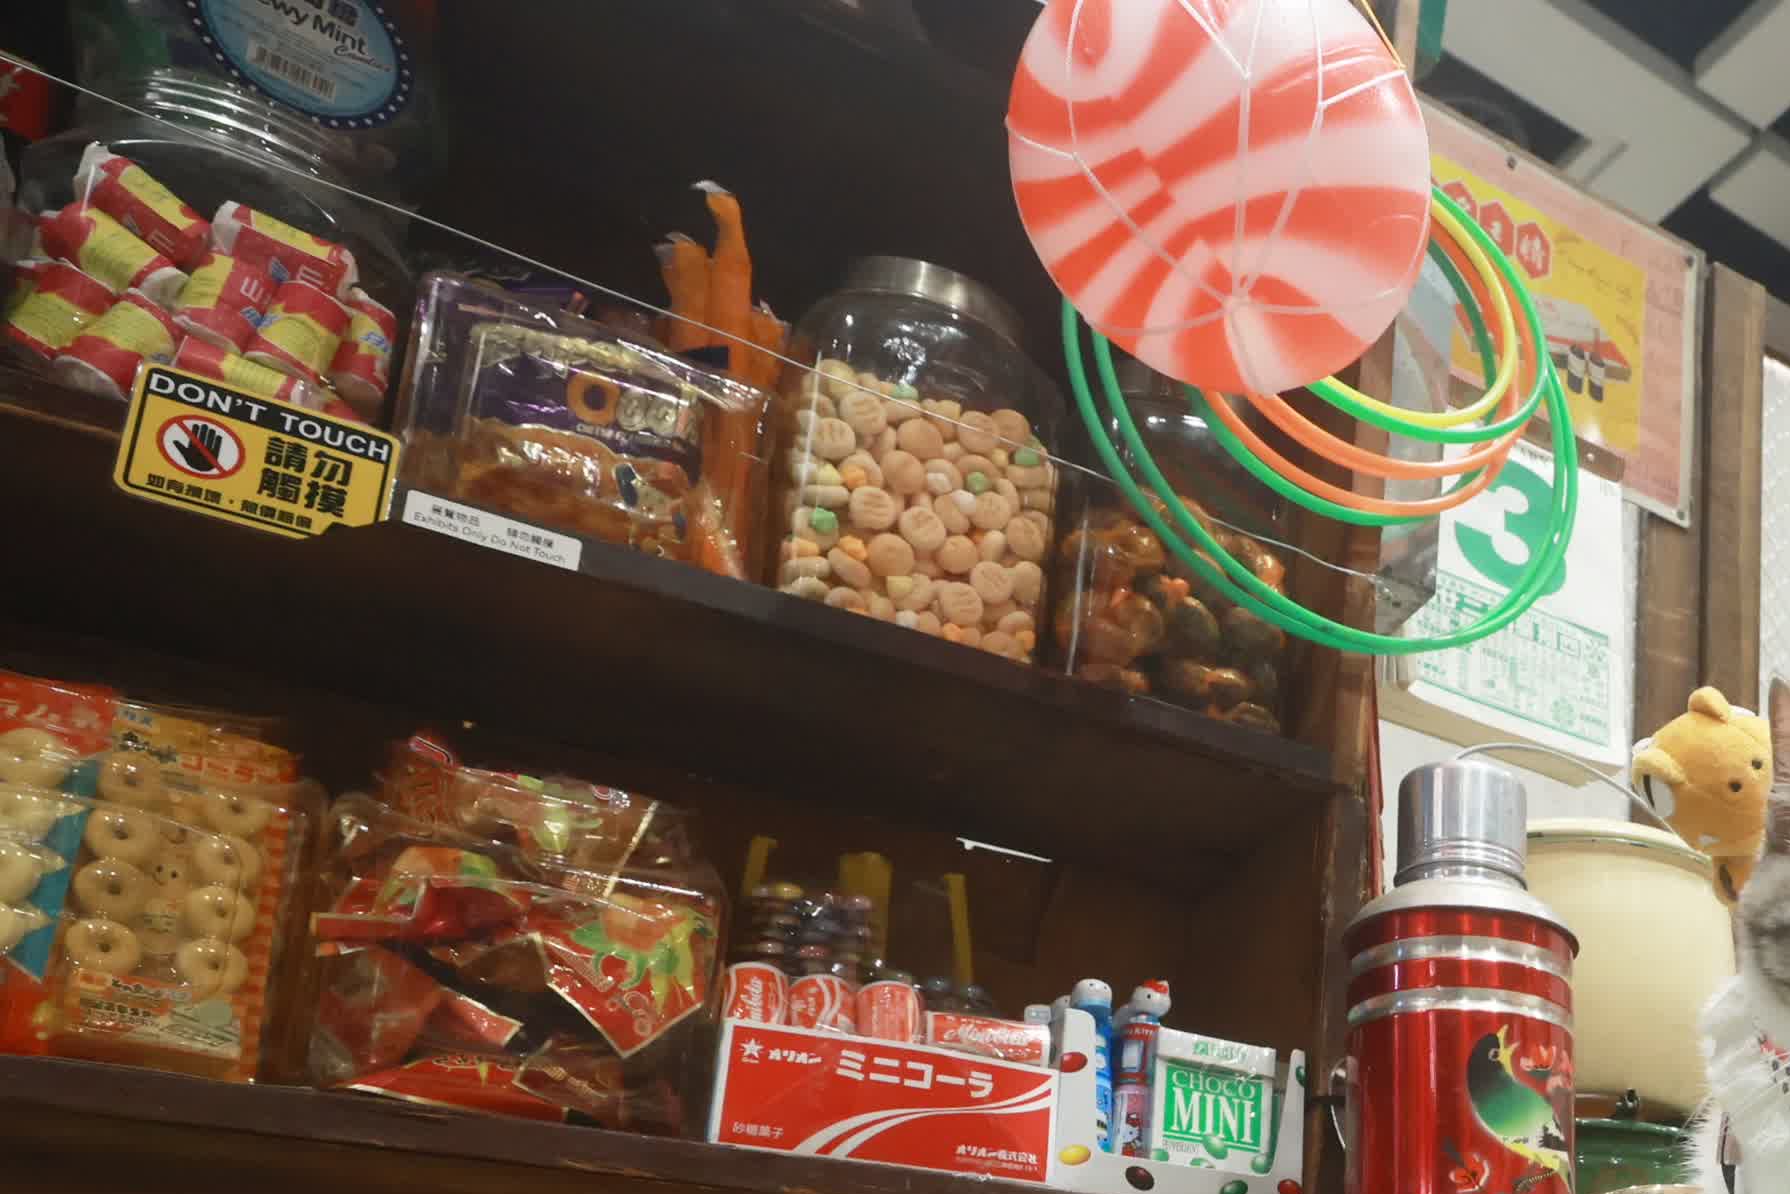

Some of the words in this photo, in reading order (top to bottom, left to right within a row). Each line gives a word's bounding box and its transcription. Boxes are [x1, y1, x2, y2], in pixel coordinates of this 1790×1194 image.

[312, 14, 367, 55] Mint
[150, 373, 268, 422] DON'T
[279, 412, 389, 463] TOUCH
[264, 435, 353, 487] 請勿
[257, 467, 348, 518] 觸摸
[414, 512, 459, 532] Exhibits
[462, 526, 488, 544] Only
[491, 534, 507, 547] Do
[511, 539, 531, 554] Not
[534, 546, 567, 564] Touch
[836, 1049, 994, 1098] ミニコーラ
[1171, 1069, 1257, 1100] CHOCO
[1170, 1087, 1256, 1145] MINI
